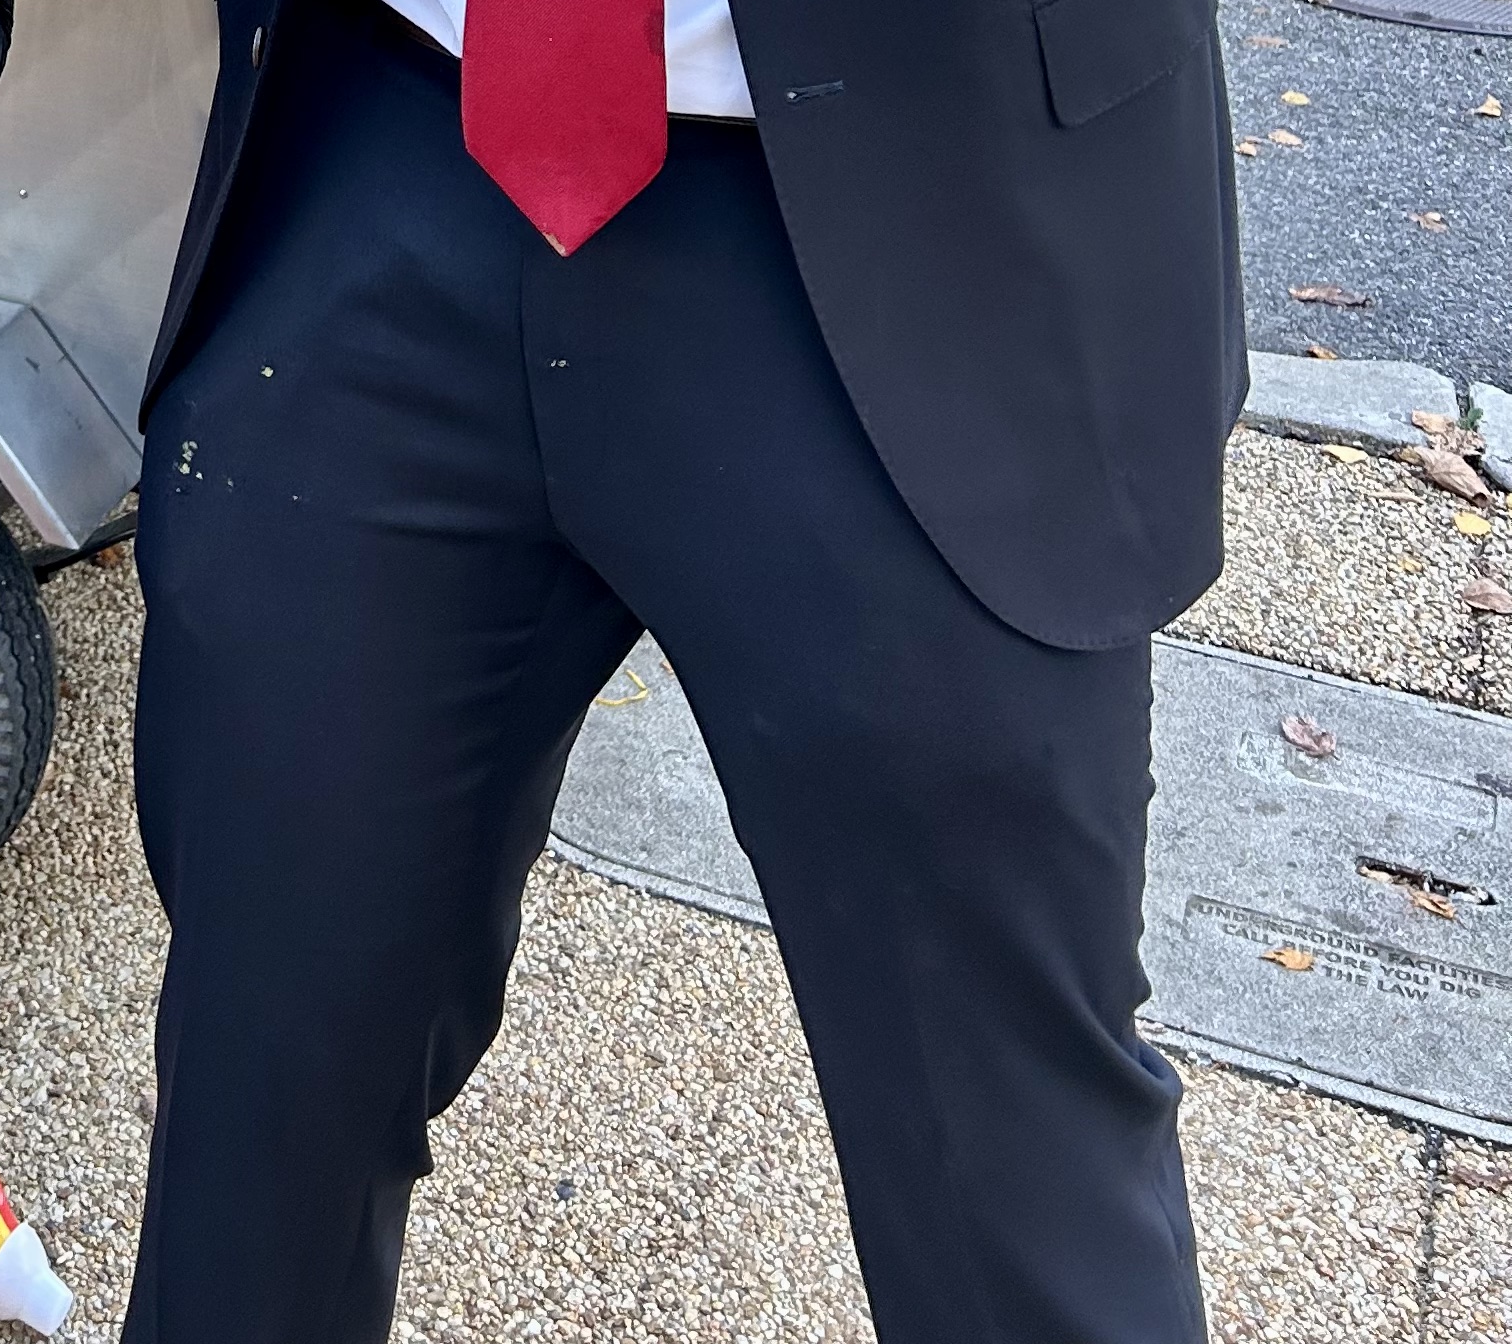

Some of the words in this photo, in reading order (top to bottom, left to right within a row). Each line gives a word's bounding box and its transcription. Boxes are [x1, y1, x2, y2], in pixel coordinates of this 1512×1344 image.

[1198, 904, 1379, 959] UNDERGROUND
[1223, 923, 1273, 946] CALL
[1380, 964, 1430, 987] YOU
[1439, 981, 1482, 1000] DIG
[1322, 966, 1368, 987] THE
[1377, 980, 1429, 1002] LAW
